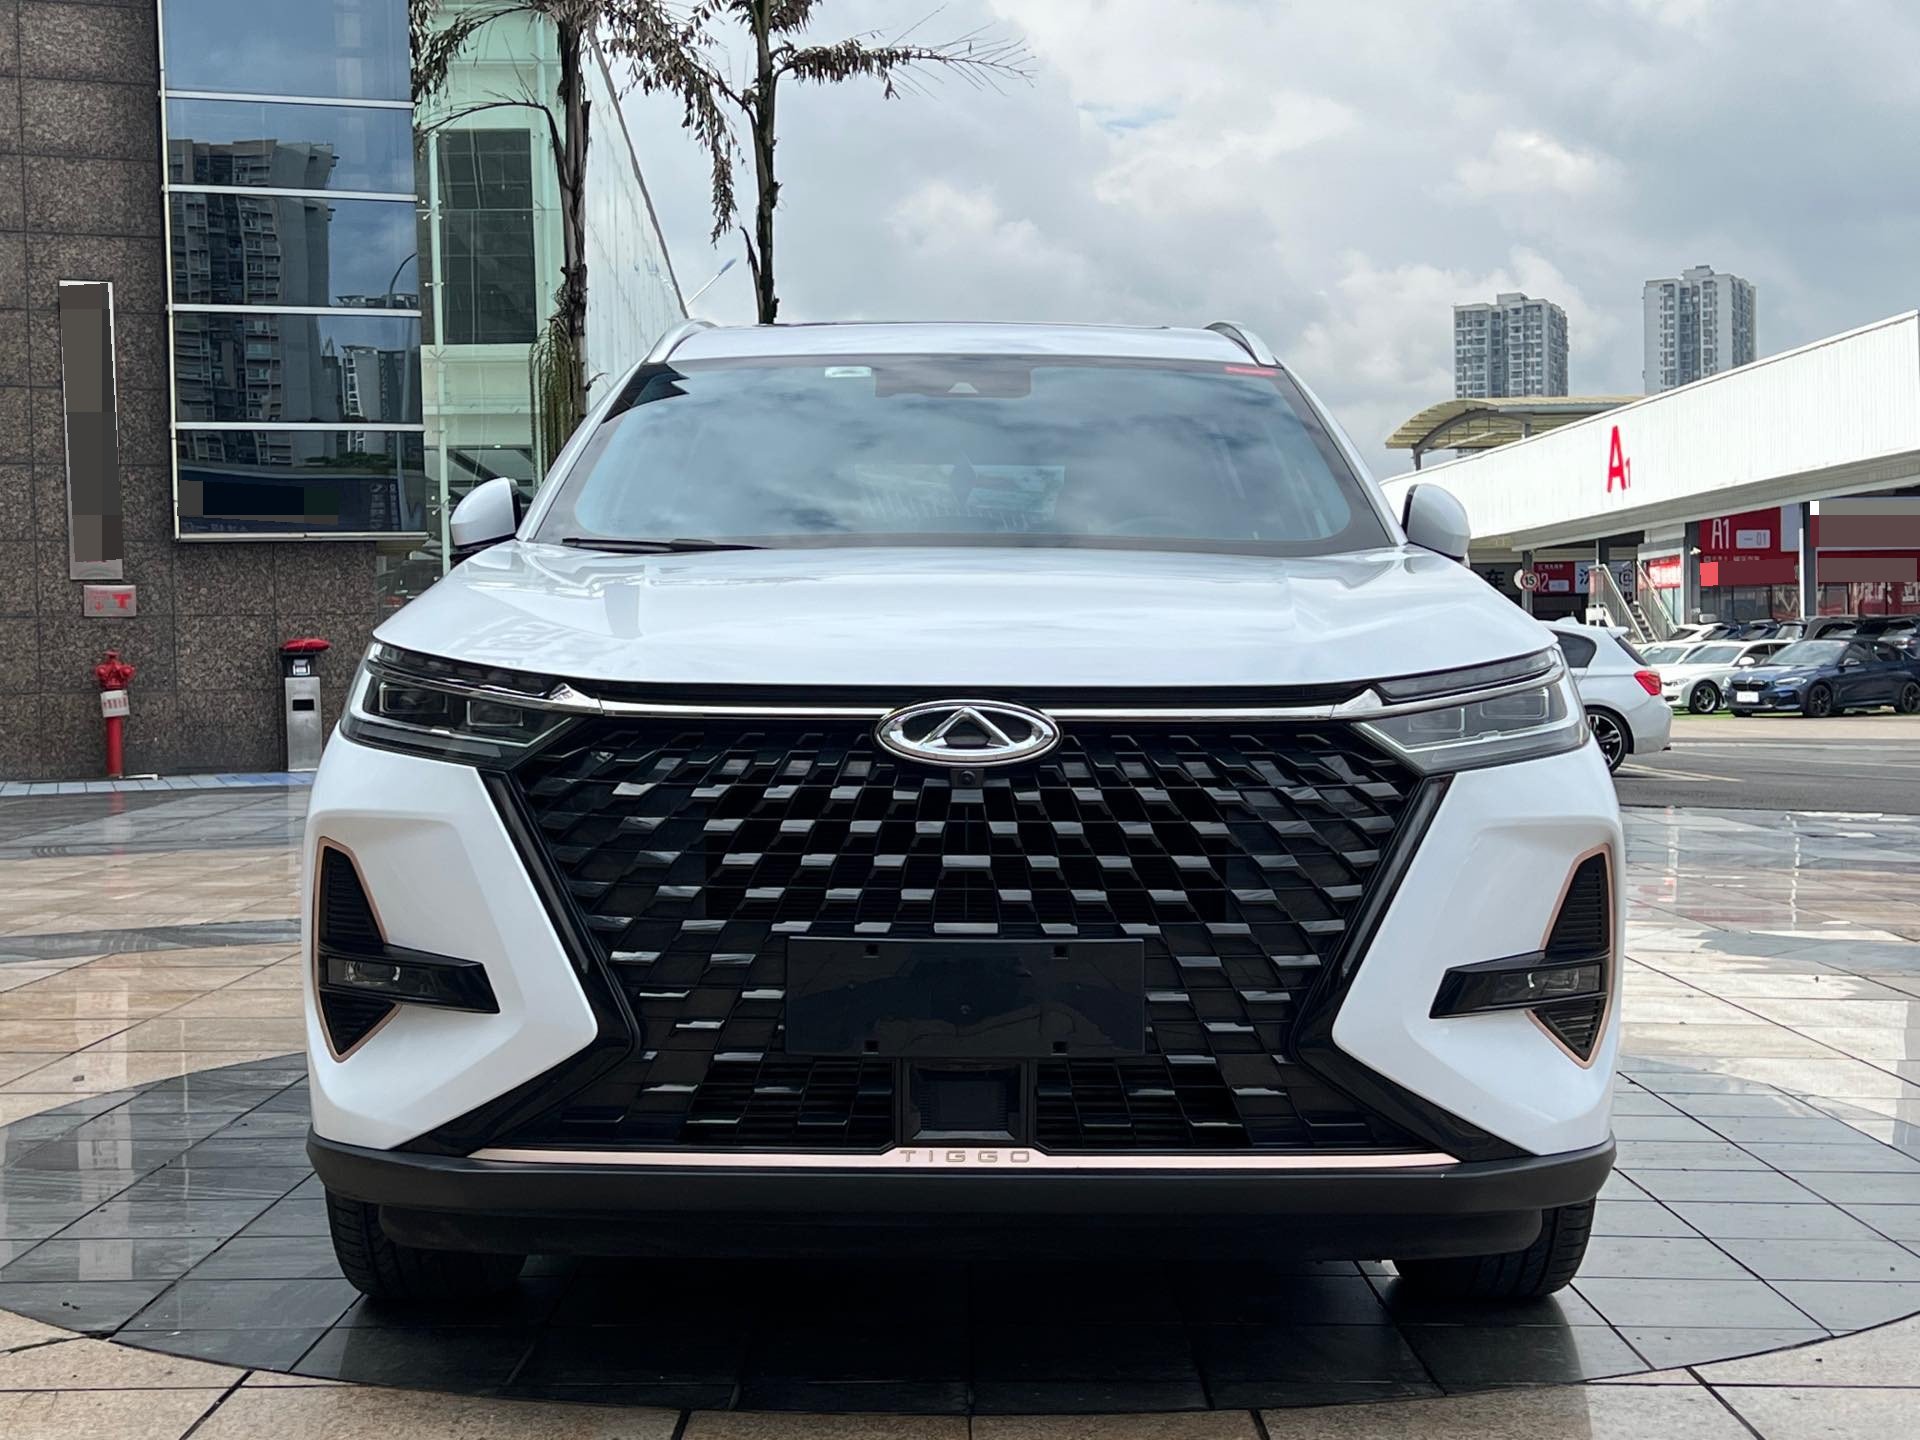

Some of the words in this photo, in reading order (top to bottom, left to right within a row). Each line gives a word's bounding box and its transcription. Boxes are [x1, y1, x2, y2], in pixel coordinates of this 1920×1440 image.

[1607, 425, 1631, 493] A1
[1711, 519, 1729, 549] A1
[1525, 576, 1535, 585] 15
[899, 1149, 1030, 1163] TIGGO
